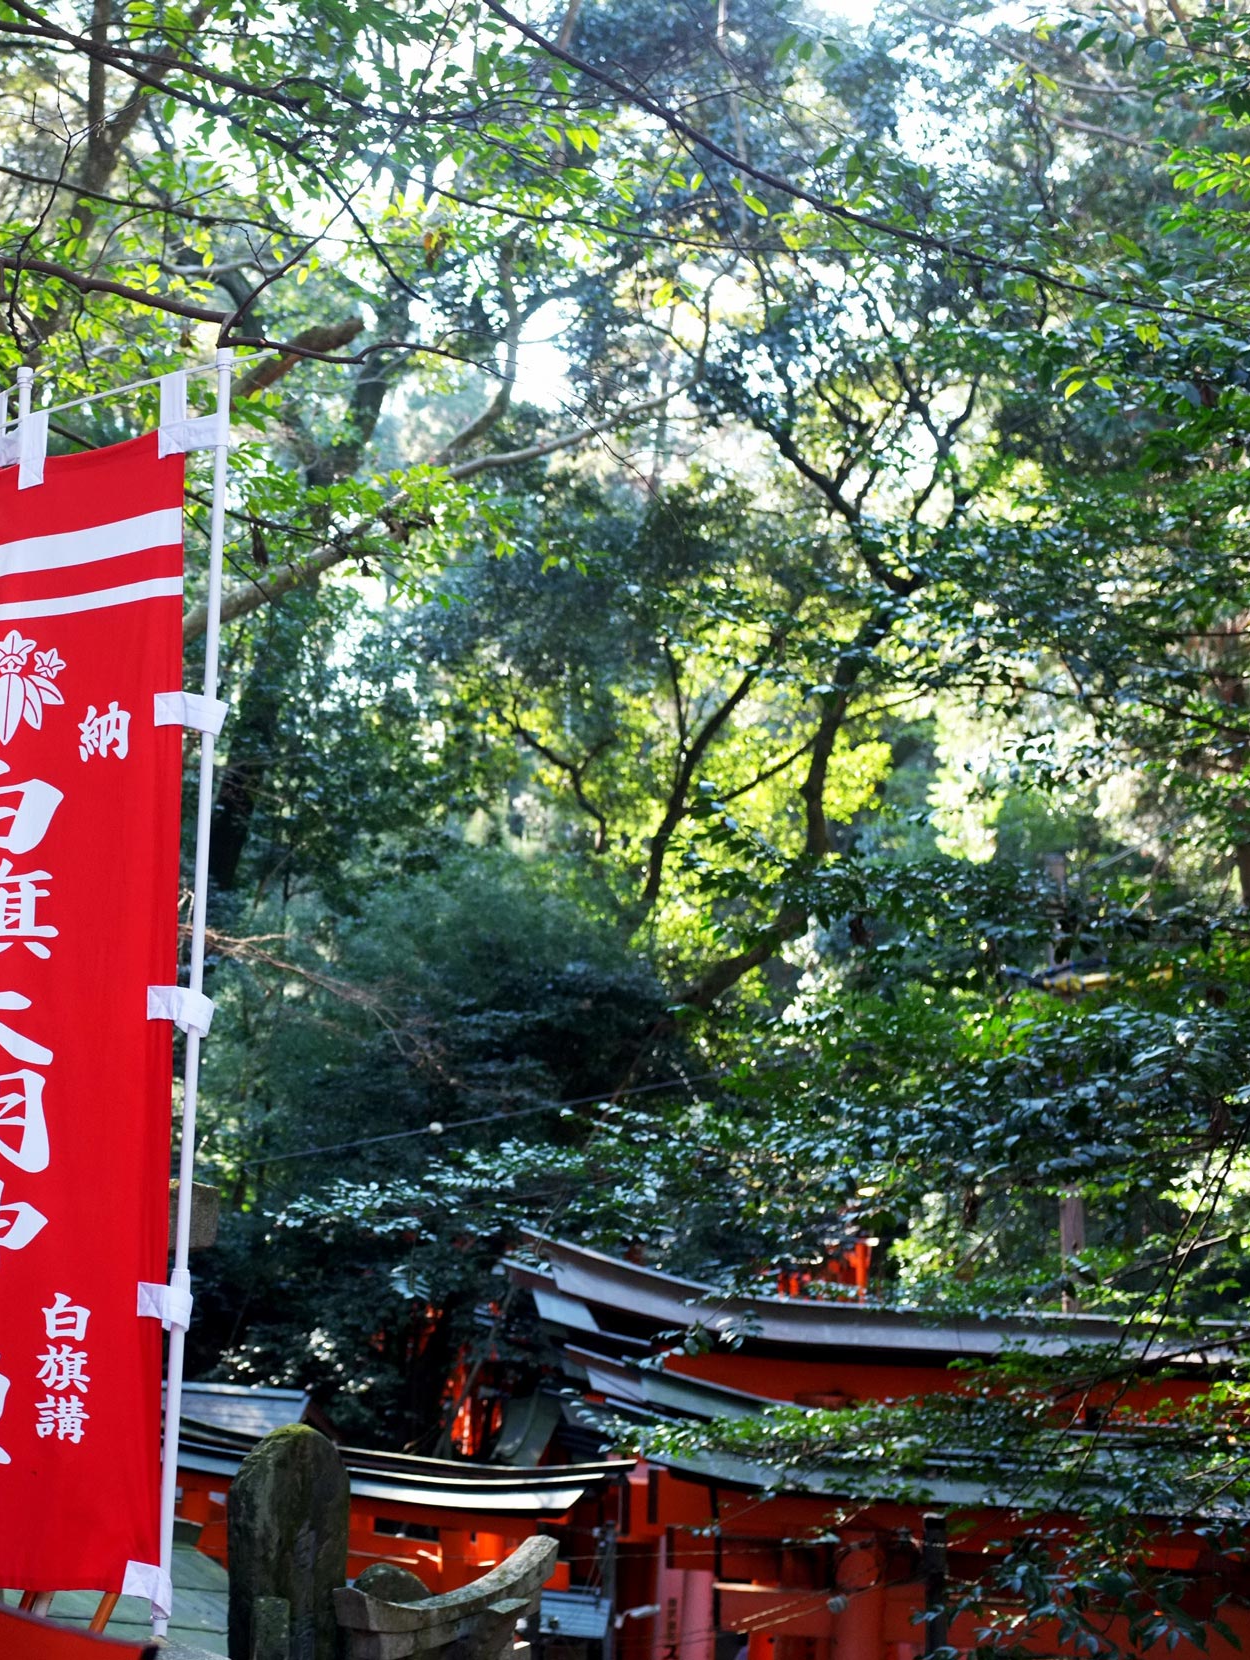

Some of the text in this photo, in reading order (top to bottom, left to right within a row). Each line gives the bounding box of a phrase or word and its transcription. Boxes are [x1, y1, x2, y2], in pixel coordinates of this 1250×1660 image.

[78, 701, 132, 763] 納
[34, 1292, 91, 1444] 白旗講
